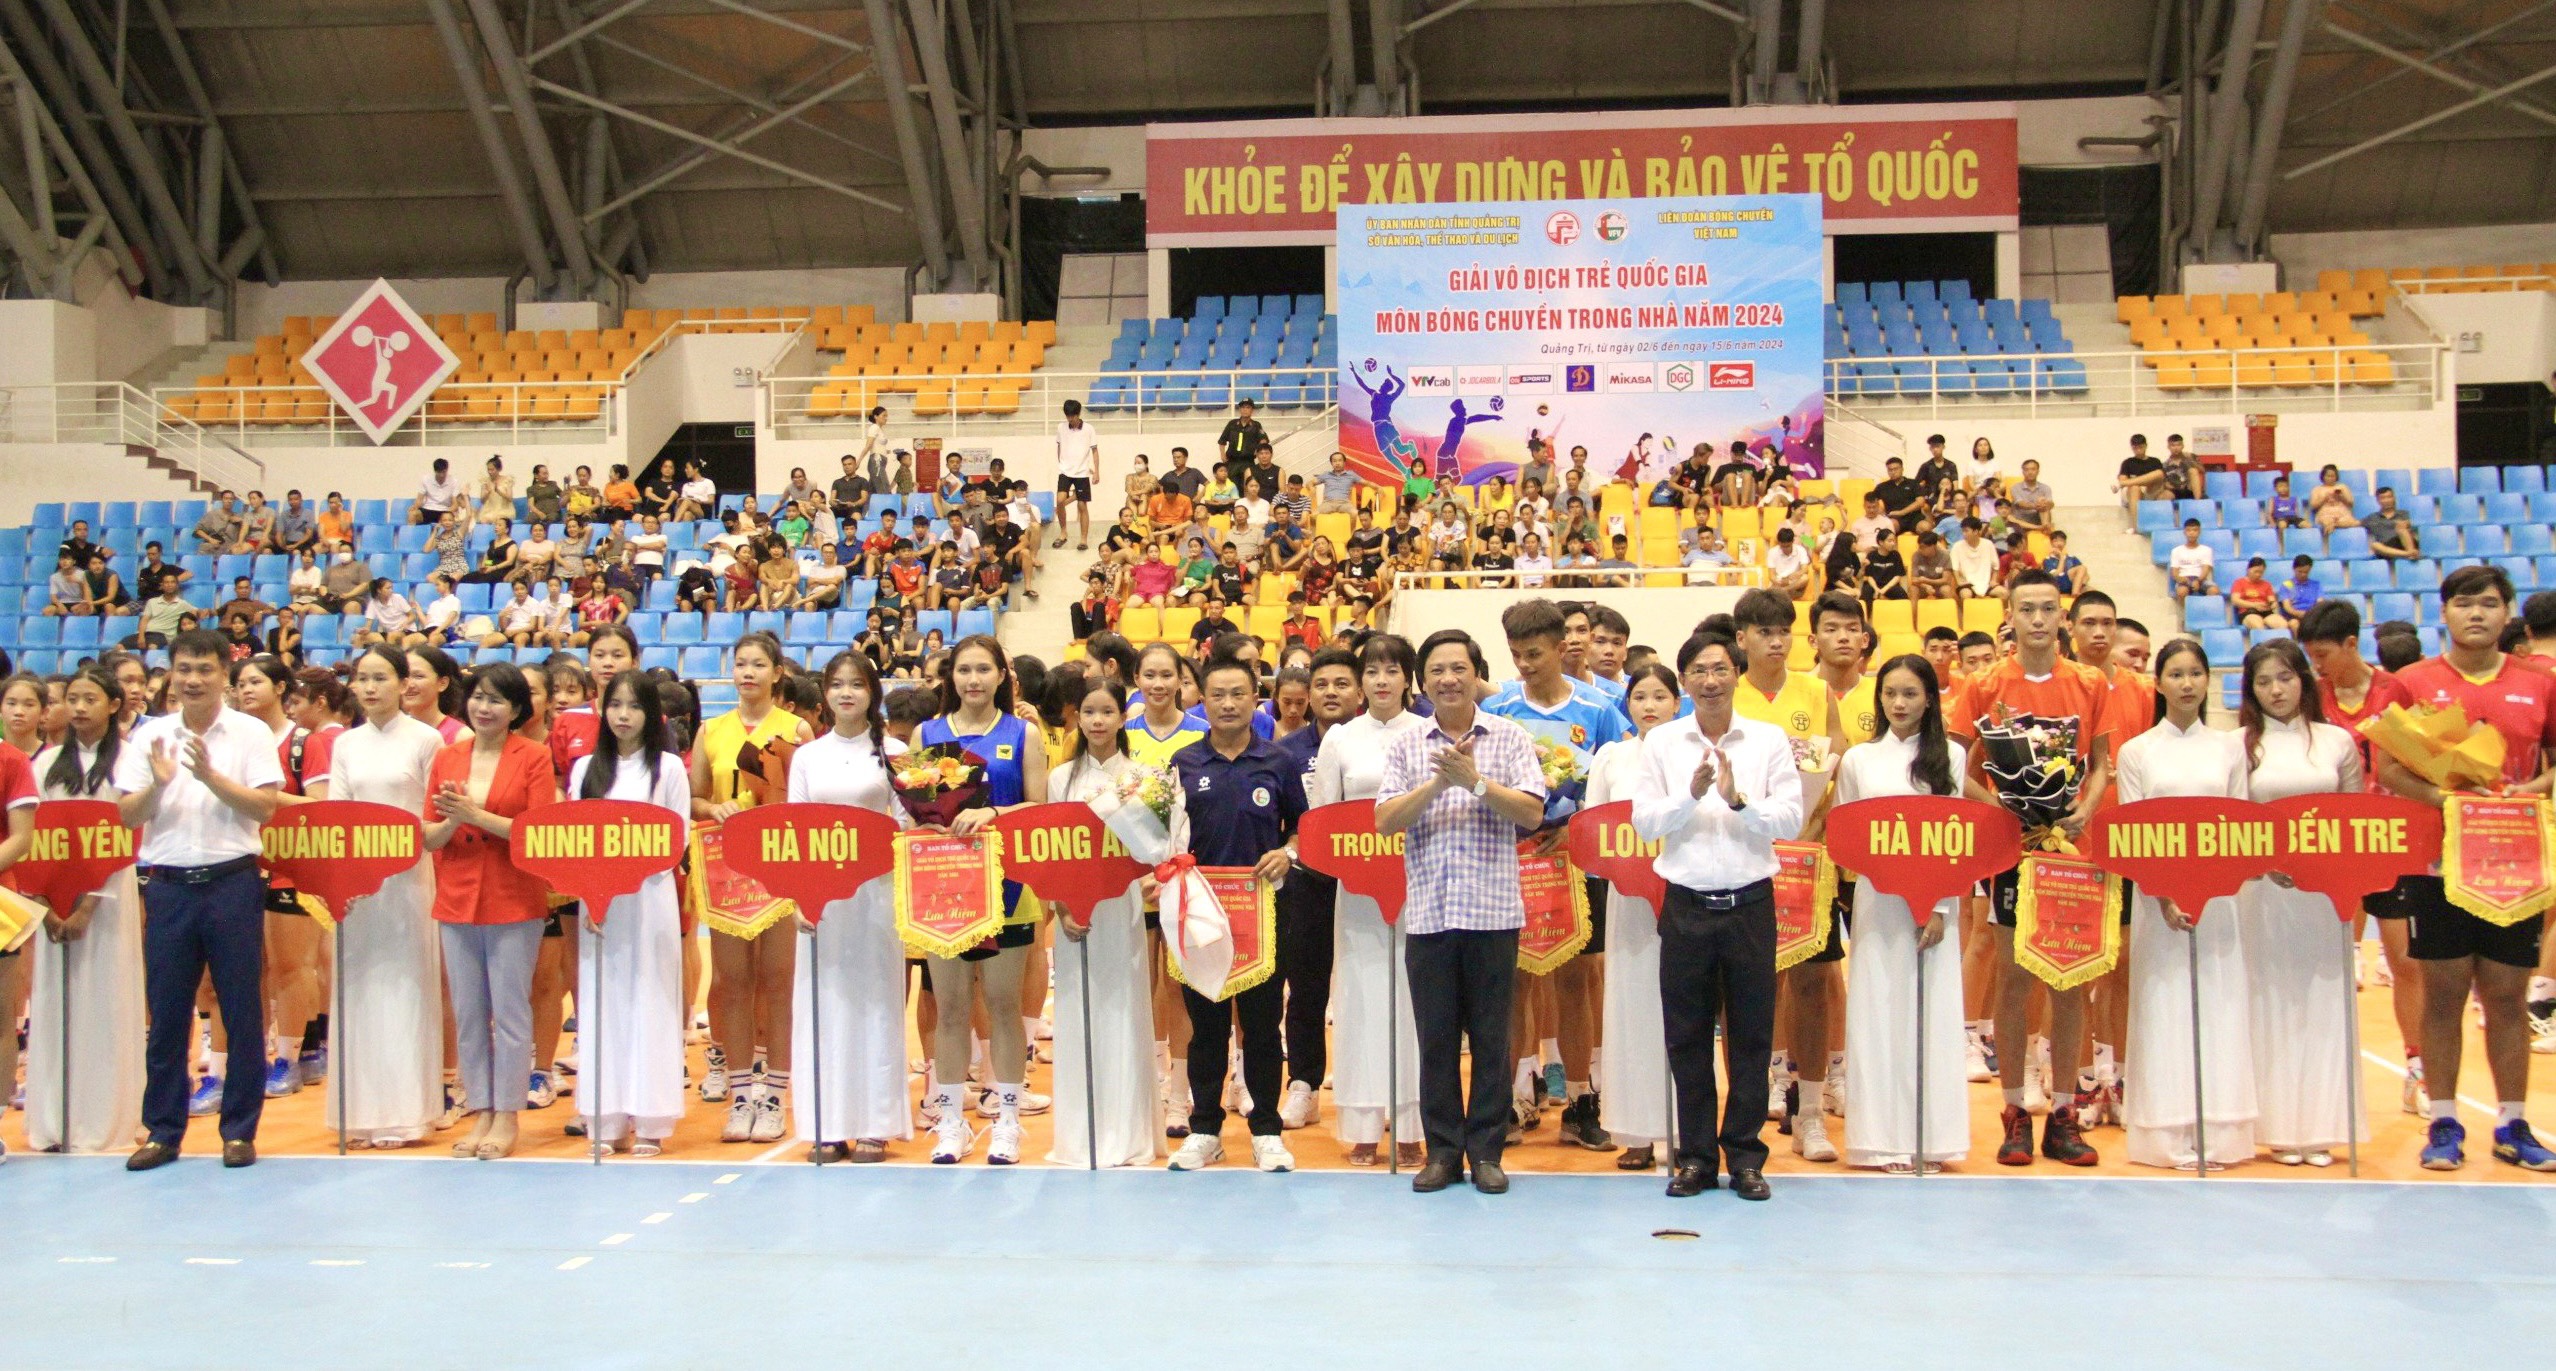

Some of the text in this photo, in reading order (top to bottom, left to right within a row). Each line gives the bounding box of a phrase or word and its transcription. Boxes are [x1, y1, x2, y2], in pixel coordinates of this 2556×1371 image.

[1184, 144, 1287, 216] KHỎE
[1299, 143, 1353, 214] ĐỂ
[1364, 152, 1442, 205] XÂY
[1580, 147, 1630, 199] VÀ
[1646, 135, 1727, 198] BẢO
[1804, 131, 1855, 203] TỔ
[1868, 131, 1979, 207] QUỐC
[1380, 218, 1399, 230] BAN
[1658, 211, 1679, 224] LIÊN
[1715, 228, 1738, 239] NAM
[1444, 234, 1468, 245] THAO
[1469, 232, 1481, 245] VÀ
[1483, 234, 1496, 244] DU
[1449, 258, 1708, 293] GIẢI VÔ ĐỊCH TRẺ QUỐC GIA
[1376, 301, 1784, 333] MÔN BÓNG CHUYỀN TRONG NHÀ NĂM 2024
[1541, 343, 1574, 355] Quảng
[1610, 342, 1635, 354] ngày
[1637, 342, 1658, 352] 02/6
[1683, 341, 1708, 353] ngày
[1712, 341, 1732, 350] 15/6
[1759, 340, 1783, 349] 2024
[1670, 372, 1691, 383] DGC
[78, 819, 133, 859] YÊN
[262, 815, 414, 862] QUẢNG NINH
[525, 825, 595, 858] NINH
[603, 816, 671, 857] BÌNH
[762, 820, 858, 869] HÀ NỘI
[1015, 825, 1130, 862] LONG A
[1330, 832, 1406, 862] TRỌNG
[1600, 823, 1665, 858] LON
[1870, 813, 1974, 864] HÀ NỘI
[2108, 814, 2274, 858] NINH BÌNH
[2350, 818, 2408, 853] TRE
